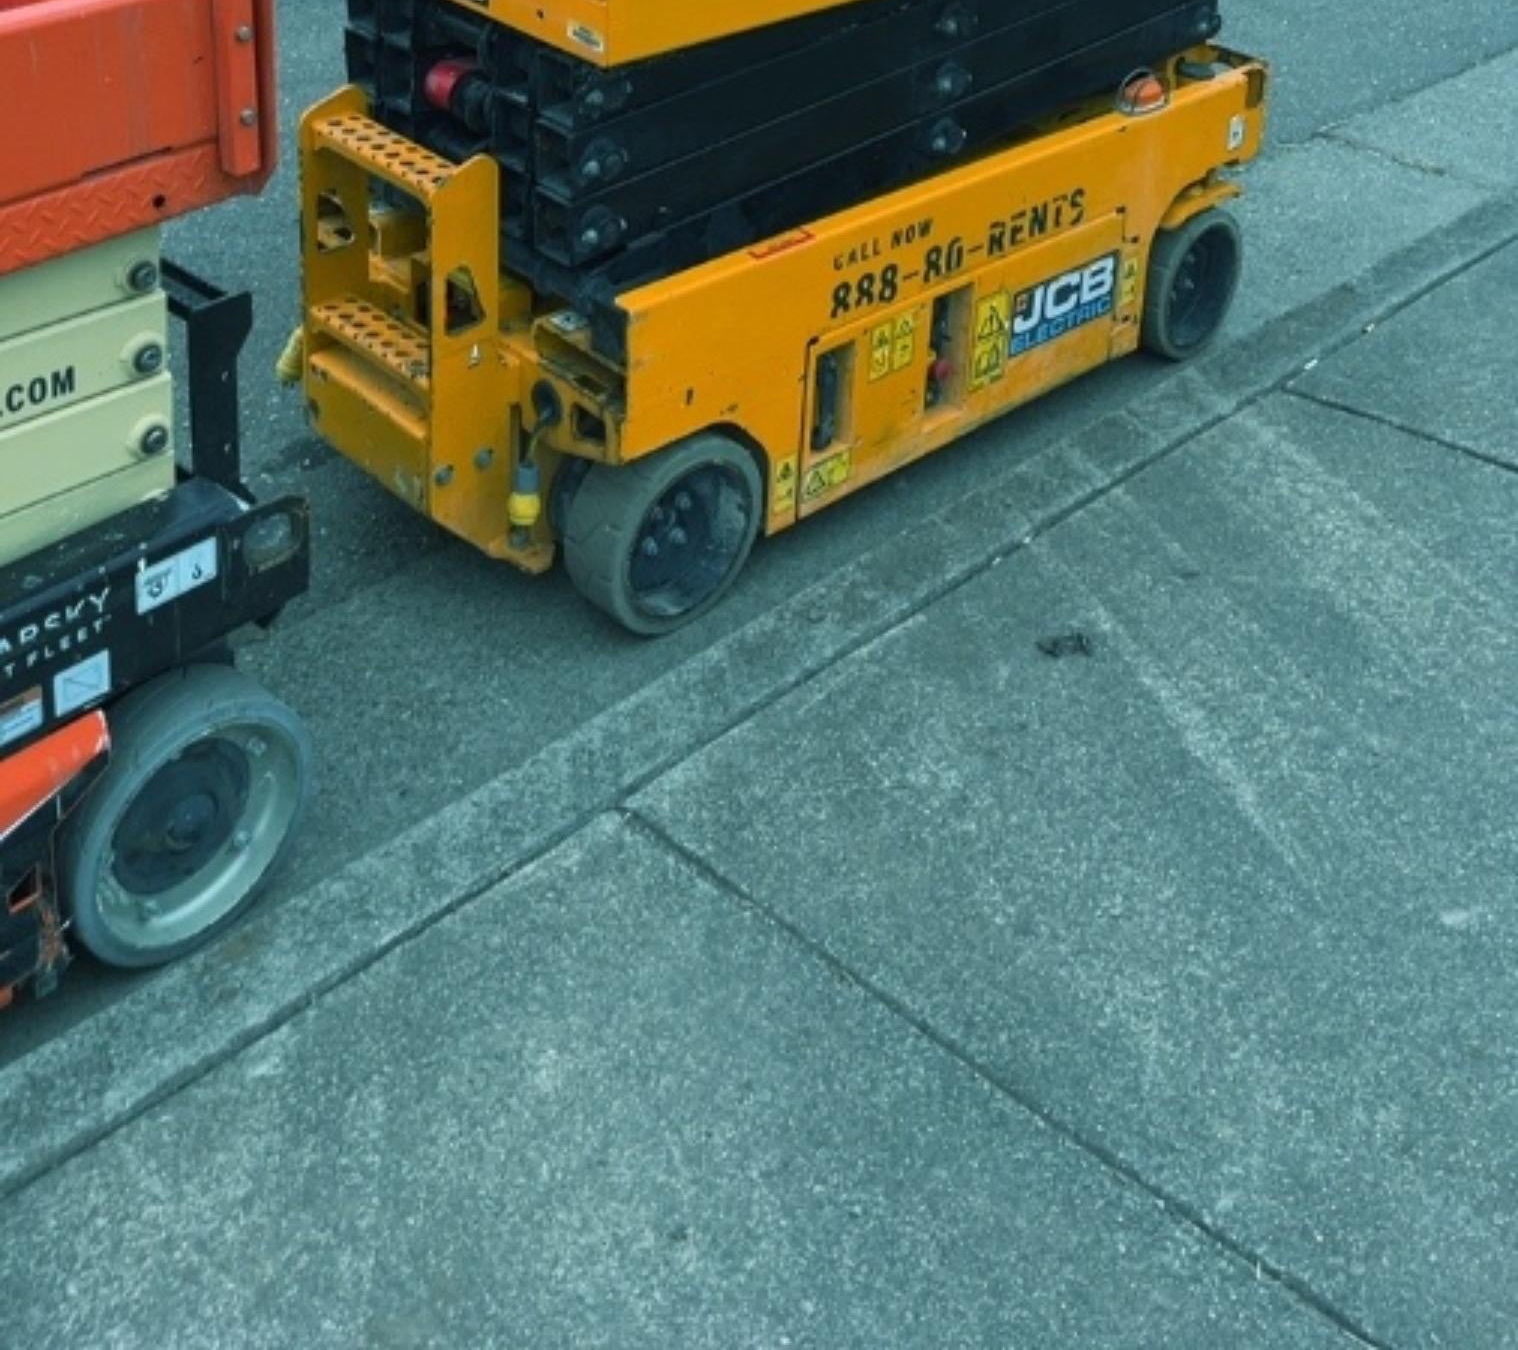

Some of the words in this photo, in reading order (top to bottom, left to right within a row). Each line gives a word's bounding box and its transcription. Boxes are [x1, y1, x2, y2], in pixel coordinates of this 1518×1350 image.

[833, 237, 882, 271] CALL
[890, 217, 934, 249] NOW
[1012, 255, 1114, 334] JCB
[1009, 295, 1112, 356] ELECTRIC
[26, 617, 105, 668] FLEET
